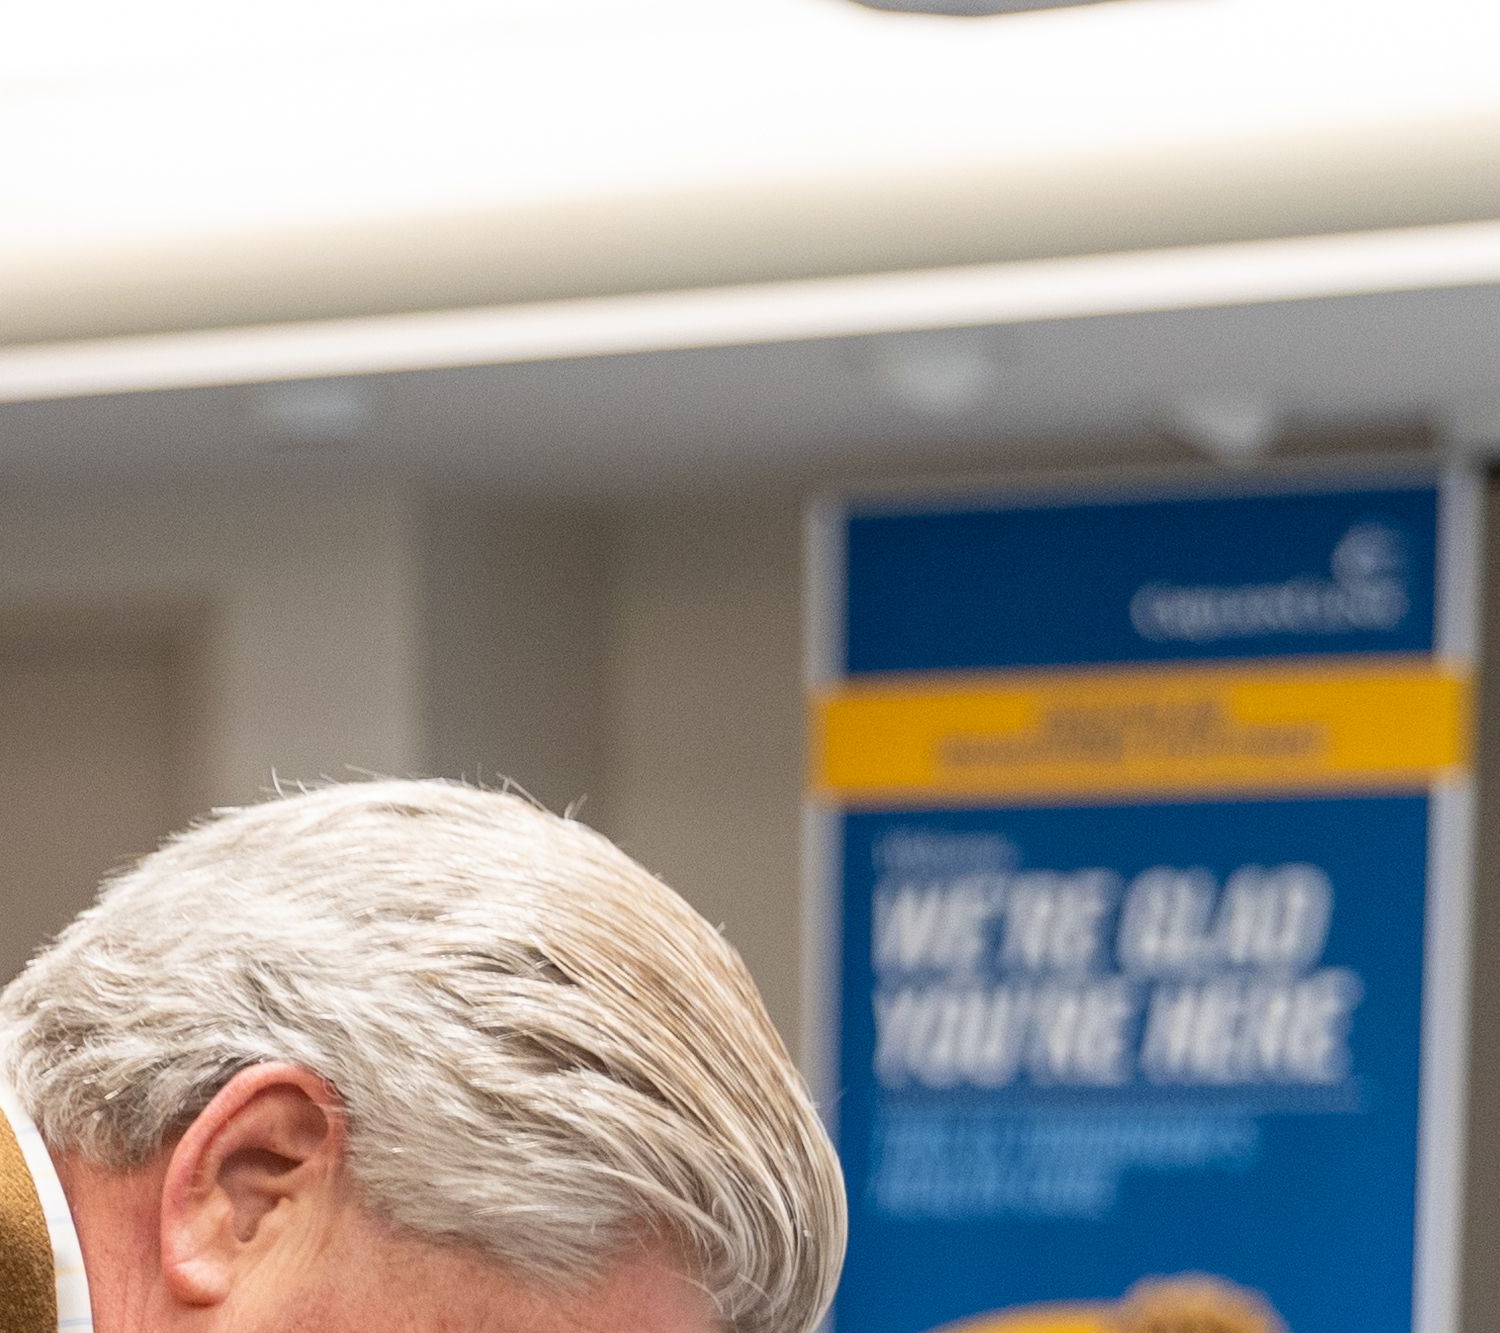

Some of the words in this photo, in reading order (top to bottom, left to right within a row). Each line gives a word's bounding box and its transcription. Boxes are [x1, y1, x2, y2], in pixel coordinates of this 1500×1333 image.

[877, 872, 1116, 976] WE'RE
[1120, 868, 1328, 972] GLAD
[877, 979, 1136, 1085] YOU'RE
[1143, 972, 1358, 1083] HERE
